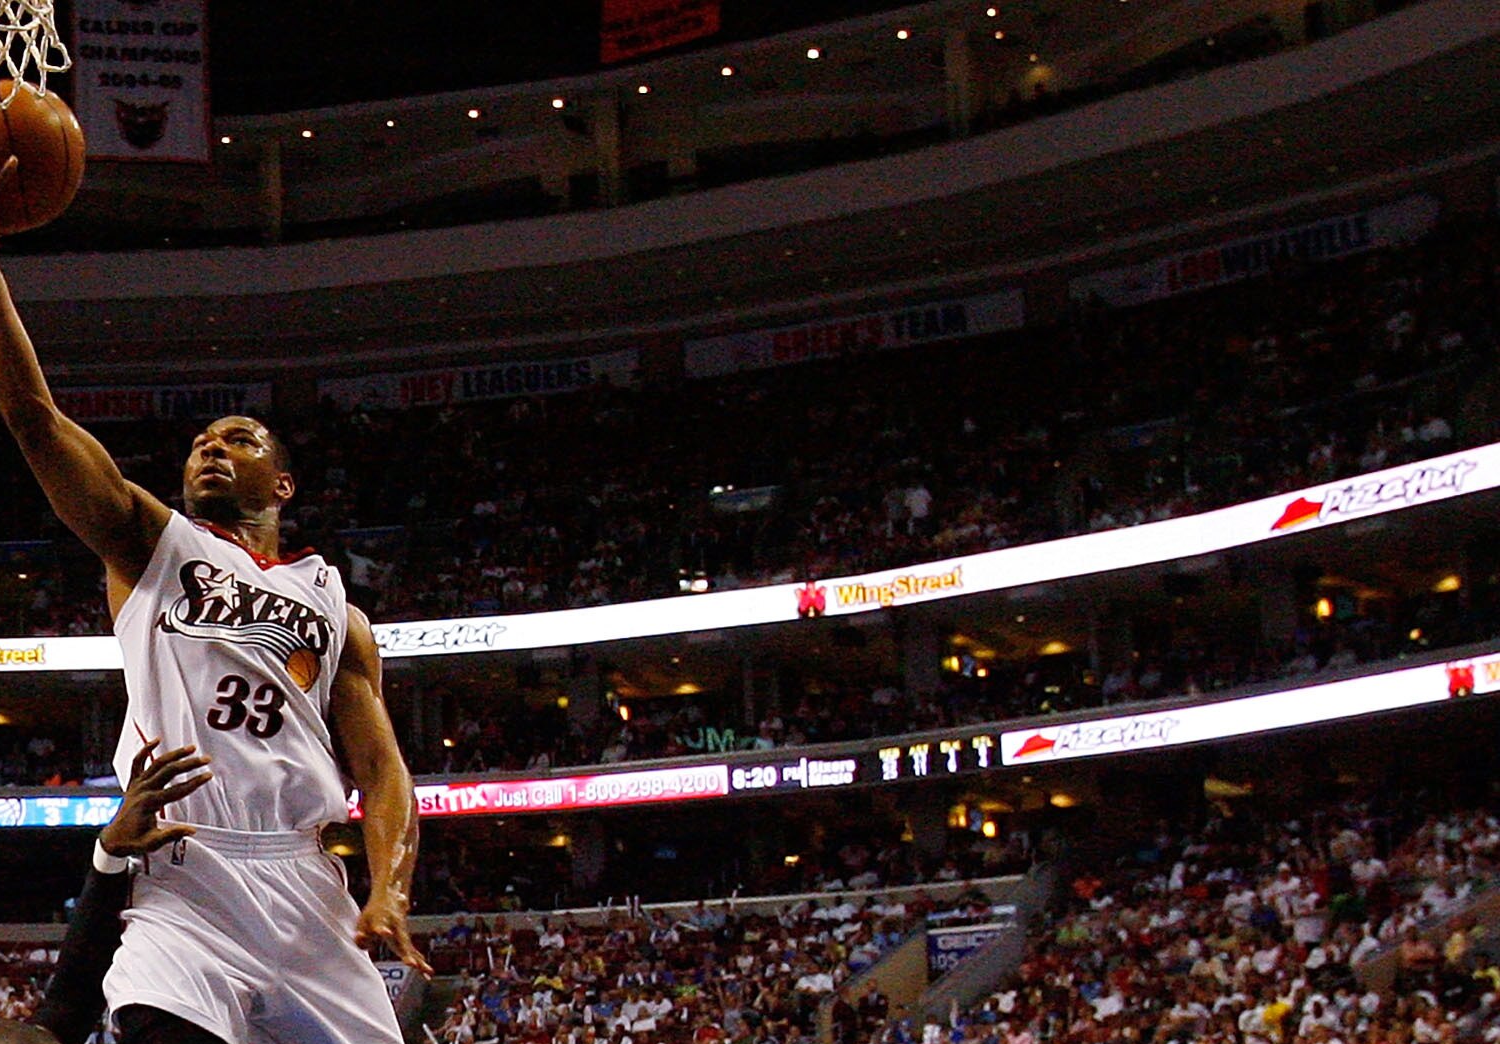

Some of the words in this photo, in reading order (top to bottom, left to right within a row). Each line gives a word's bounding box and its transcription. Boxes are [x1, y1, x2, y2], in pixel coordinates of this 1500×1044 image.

[161, 21, 199, 36] CUP
[80, 45, 202, 64] CHAMPIONS
[835, 565, 964, 608] WingStreet
[157, 559, 334, 656] SIXERS
[206, 674, 286, 738] 33
[732, 766, 777, 790] 8:20
[494, 787, 528, 808] Just
[531, 785, 563, 805] Call
